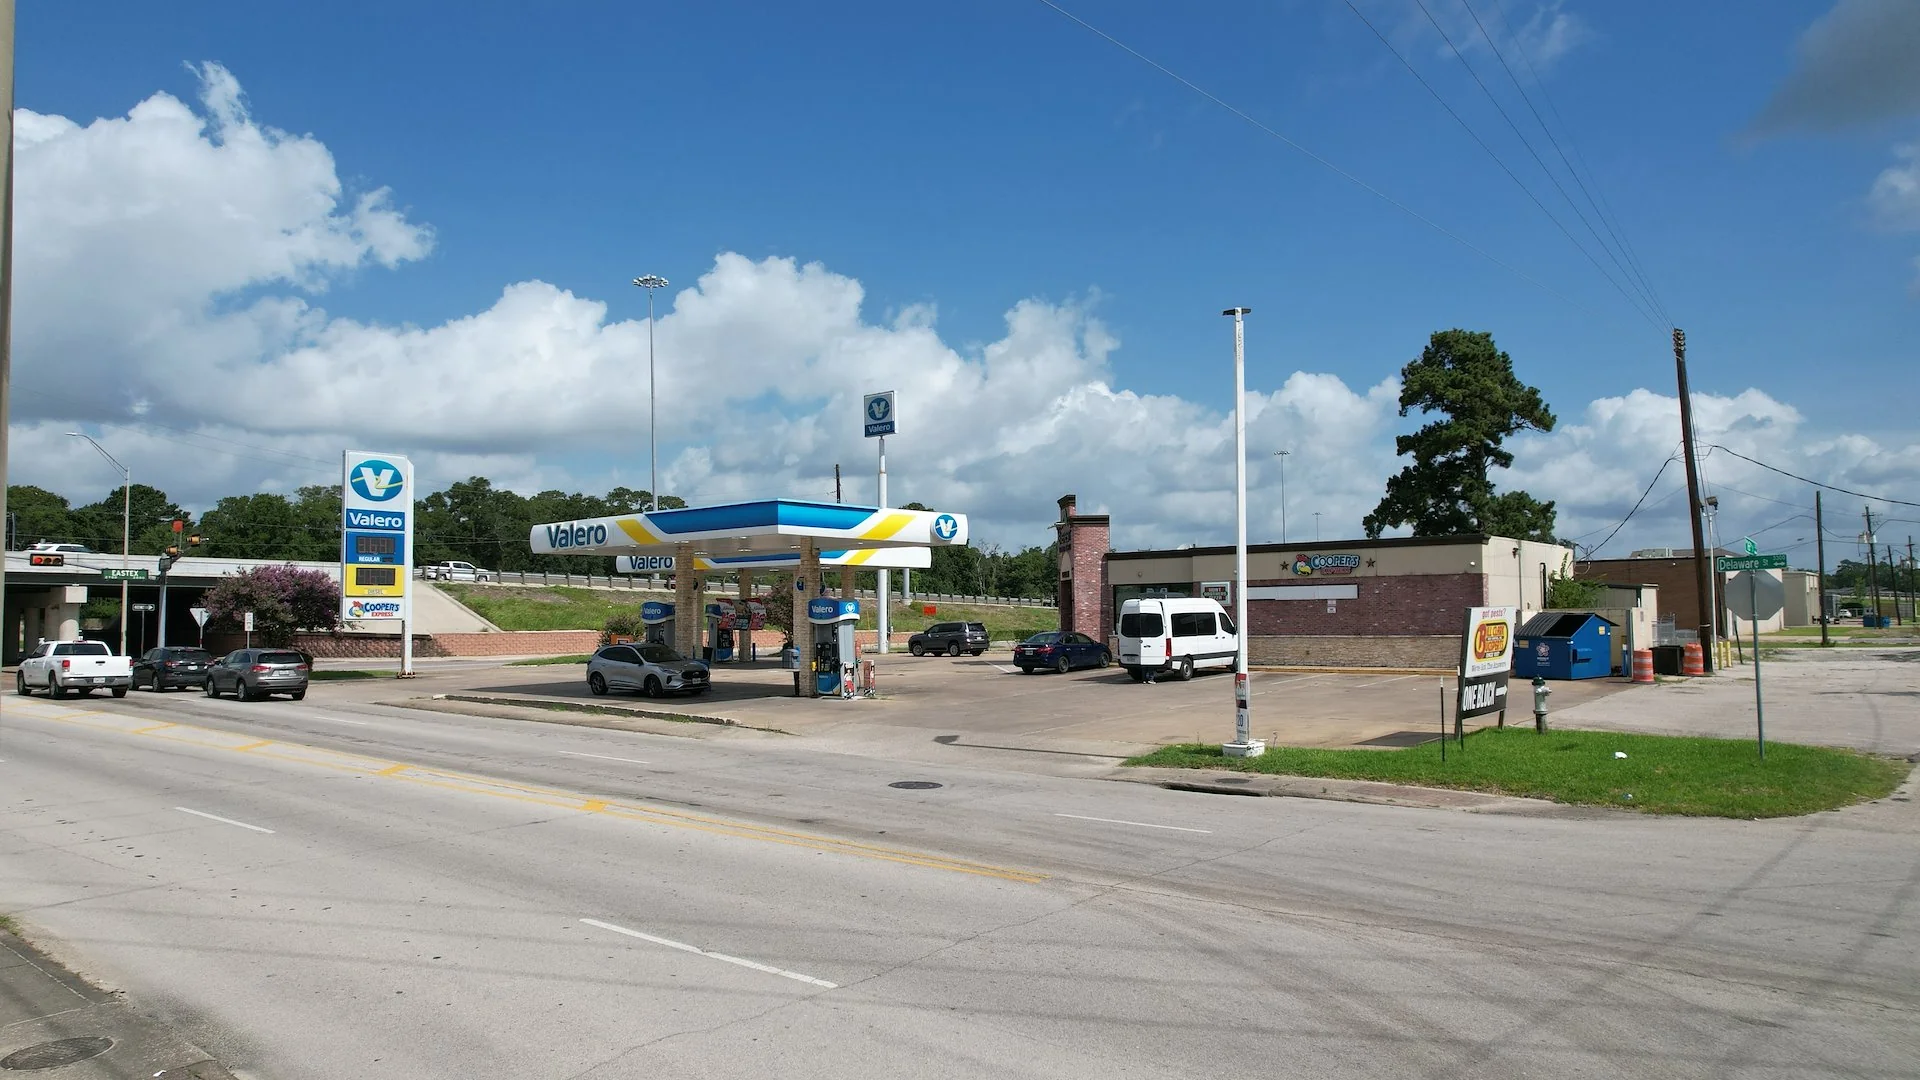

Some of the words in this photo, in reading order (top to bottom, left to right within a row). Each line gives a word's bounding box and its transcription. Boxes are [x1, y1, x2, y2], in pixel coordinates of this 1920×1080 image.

[868, 424, 891, 433] Valero
[349, 512, 403, 528] Valero
[546, 522, 607, 548] Valero
[629, 556, 674, 570] Valero
[1310, 554, 1360, 569] COOPER'S
[1720, 560, 1759, 570] Delaware
[111, 569, 139, 577] EASTEX
[364, 602, 400, 612] COOPER'S
[643, 606, 662, 615] Valero
[811, 605, 834, 614] Valero
[1463, 685, 1477, 711] ONE
[1477, 682, 1496, 708] BLOCK
